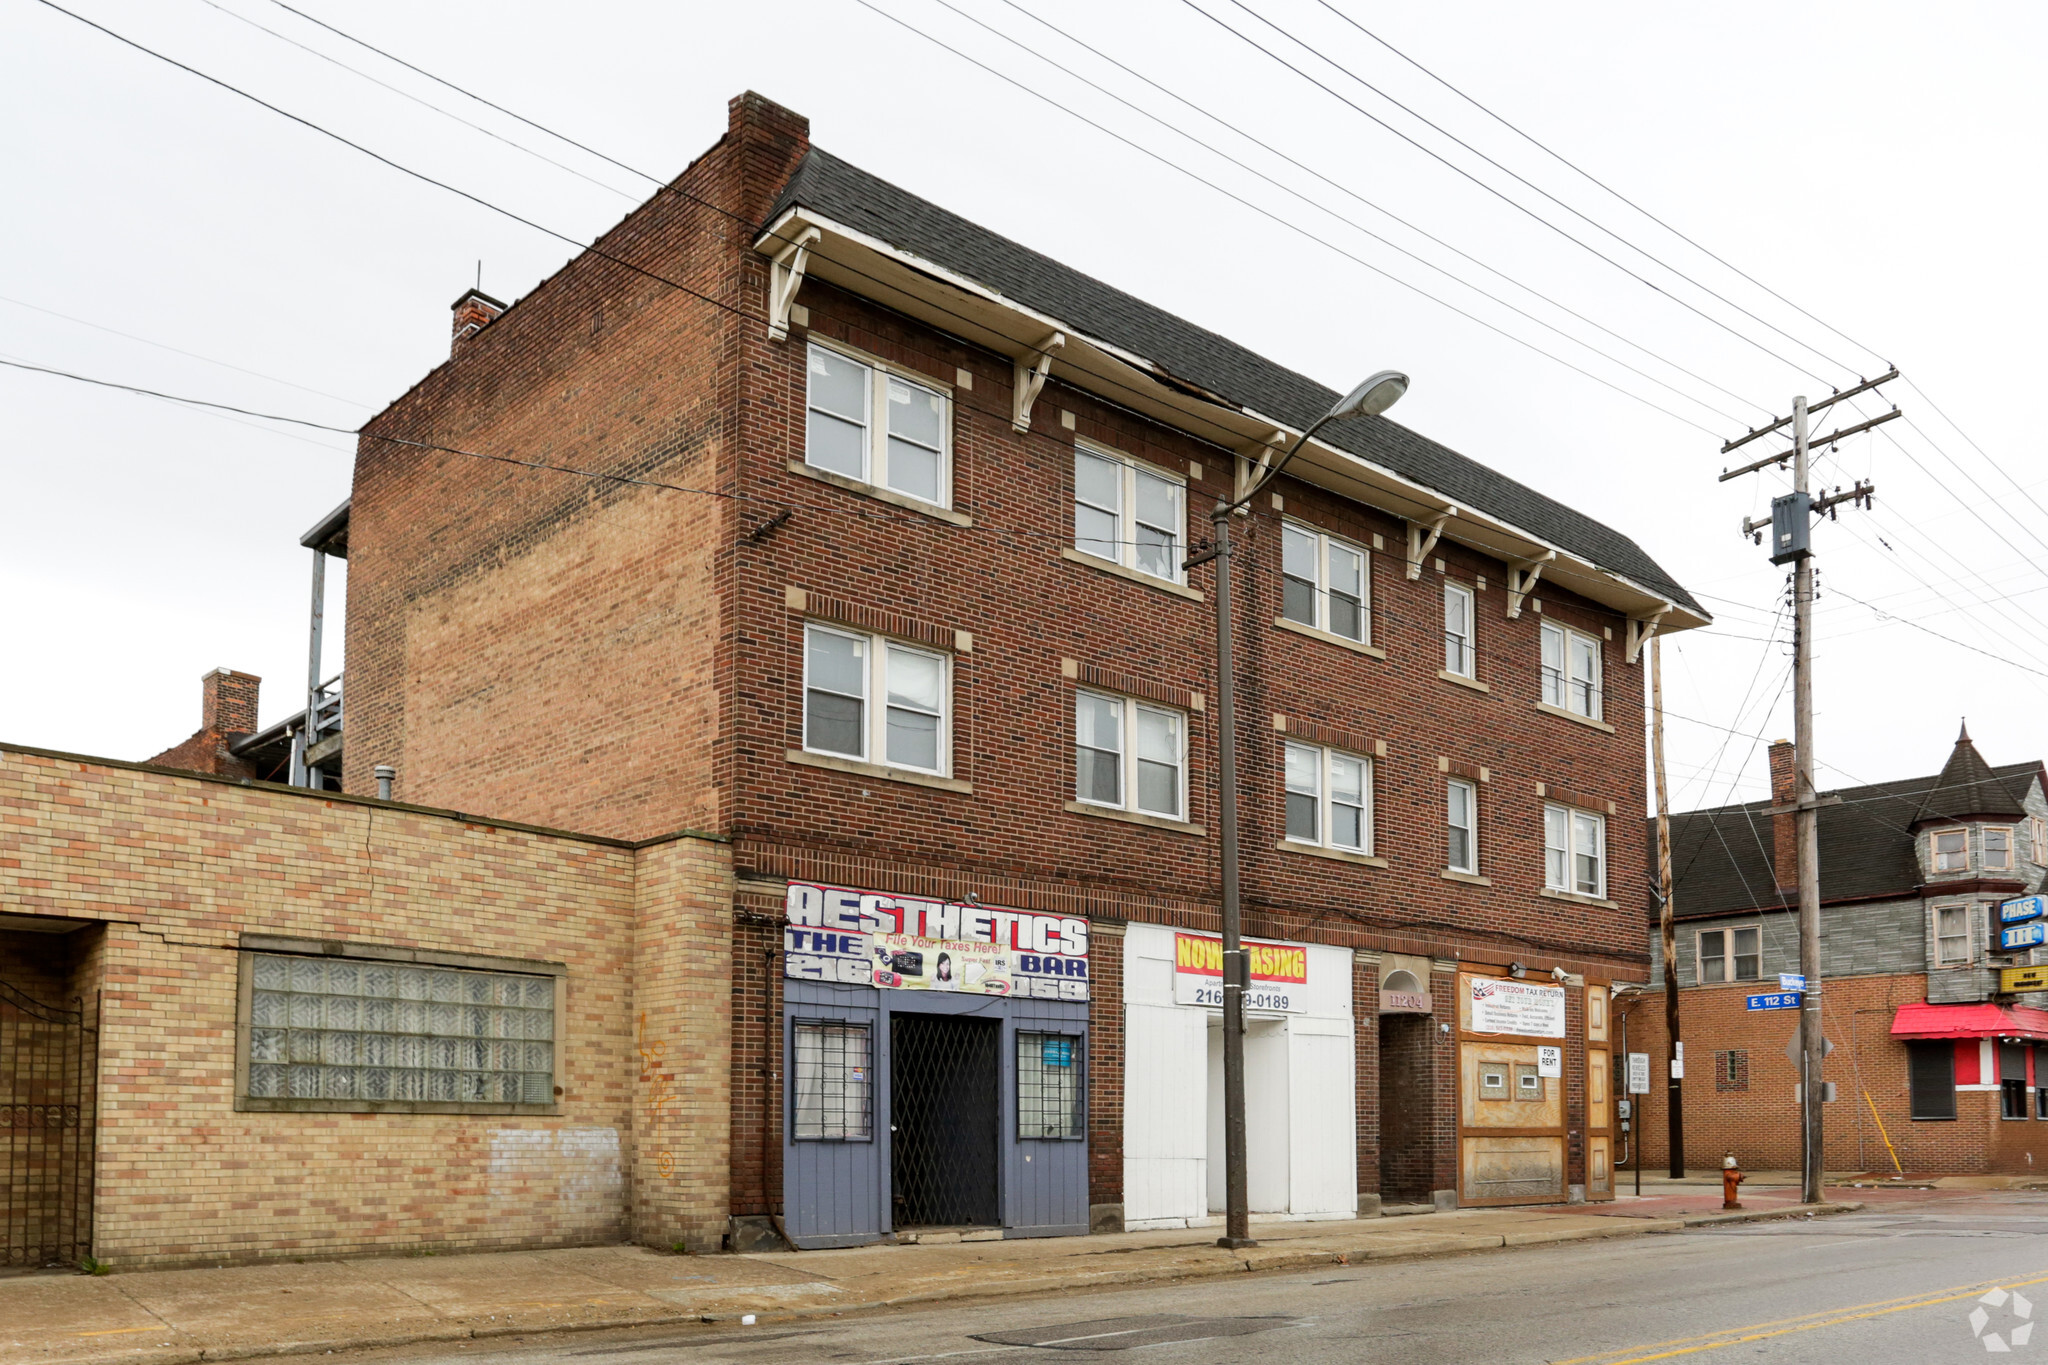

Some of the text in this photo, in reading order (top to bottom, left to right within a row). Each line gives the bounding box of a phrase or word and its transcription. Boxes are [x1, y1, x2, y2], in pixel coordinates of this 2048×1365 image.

[2003, 900, 2036, 919] PHASE
[786, 884, 1088, 956] AESTHETICS
[786, 929, 863, 955] THE
[885, 932, 1002, 954] File Your Taxes Here!
[2005, 927, 2036, 947] III
[1021, 955, 1086, 977] BAR
[1177, 937, 1305, 978] NOW ASING
[1495, 985, 1563, 998] FREEDOM TAX RETURN
[1751, 995, 1796, 1007] E. 112 St
[1390, 994, 1423, 1009] 11204
[1541, 1057, 1557, 1066] RENT
[1543, 1048, 1555, 1057] FOR
